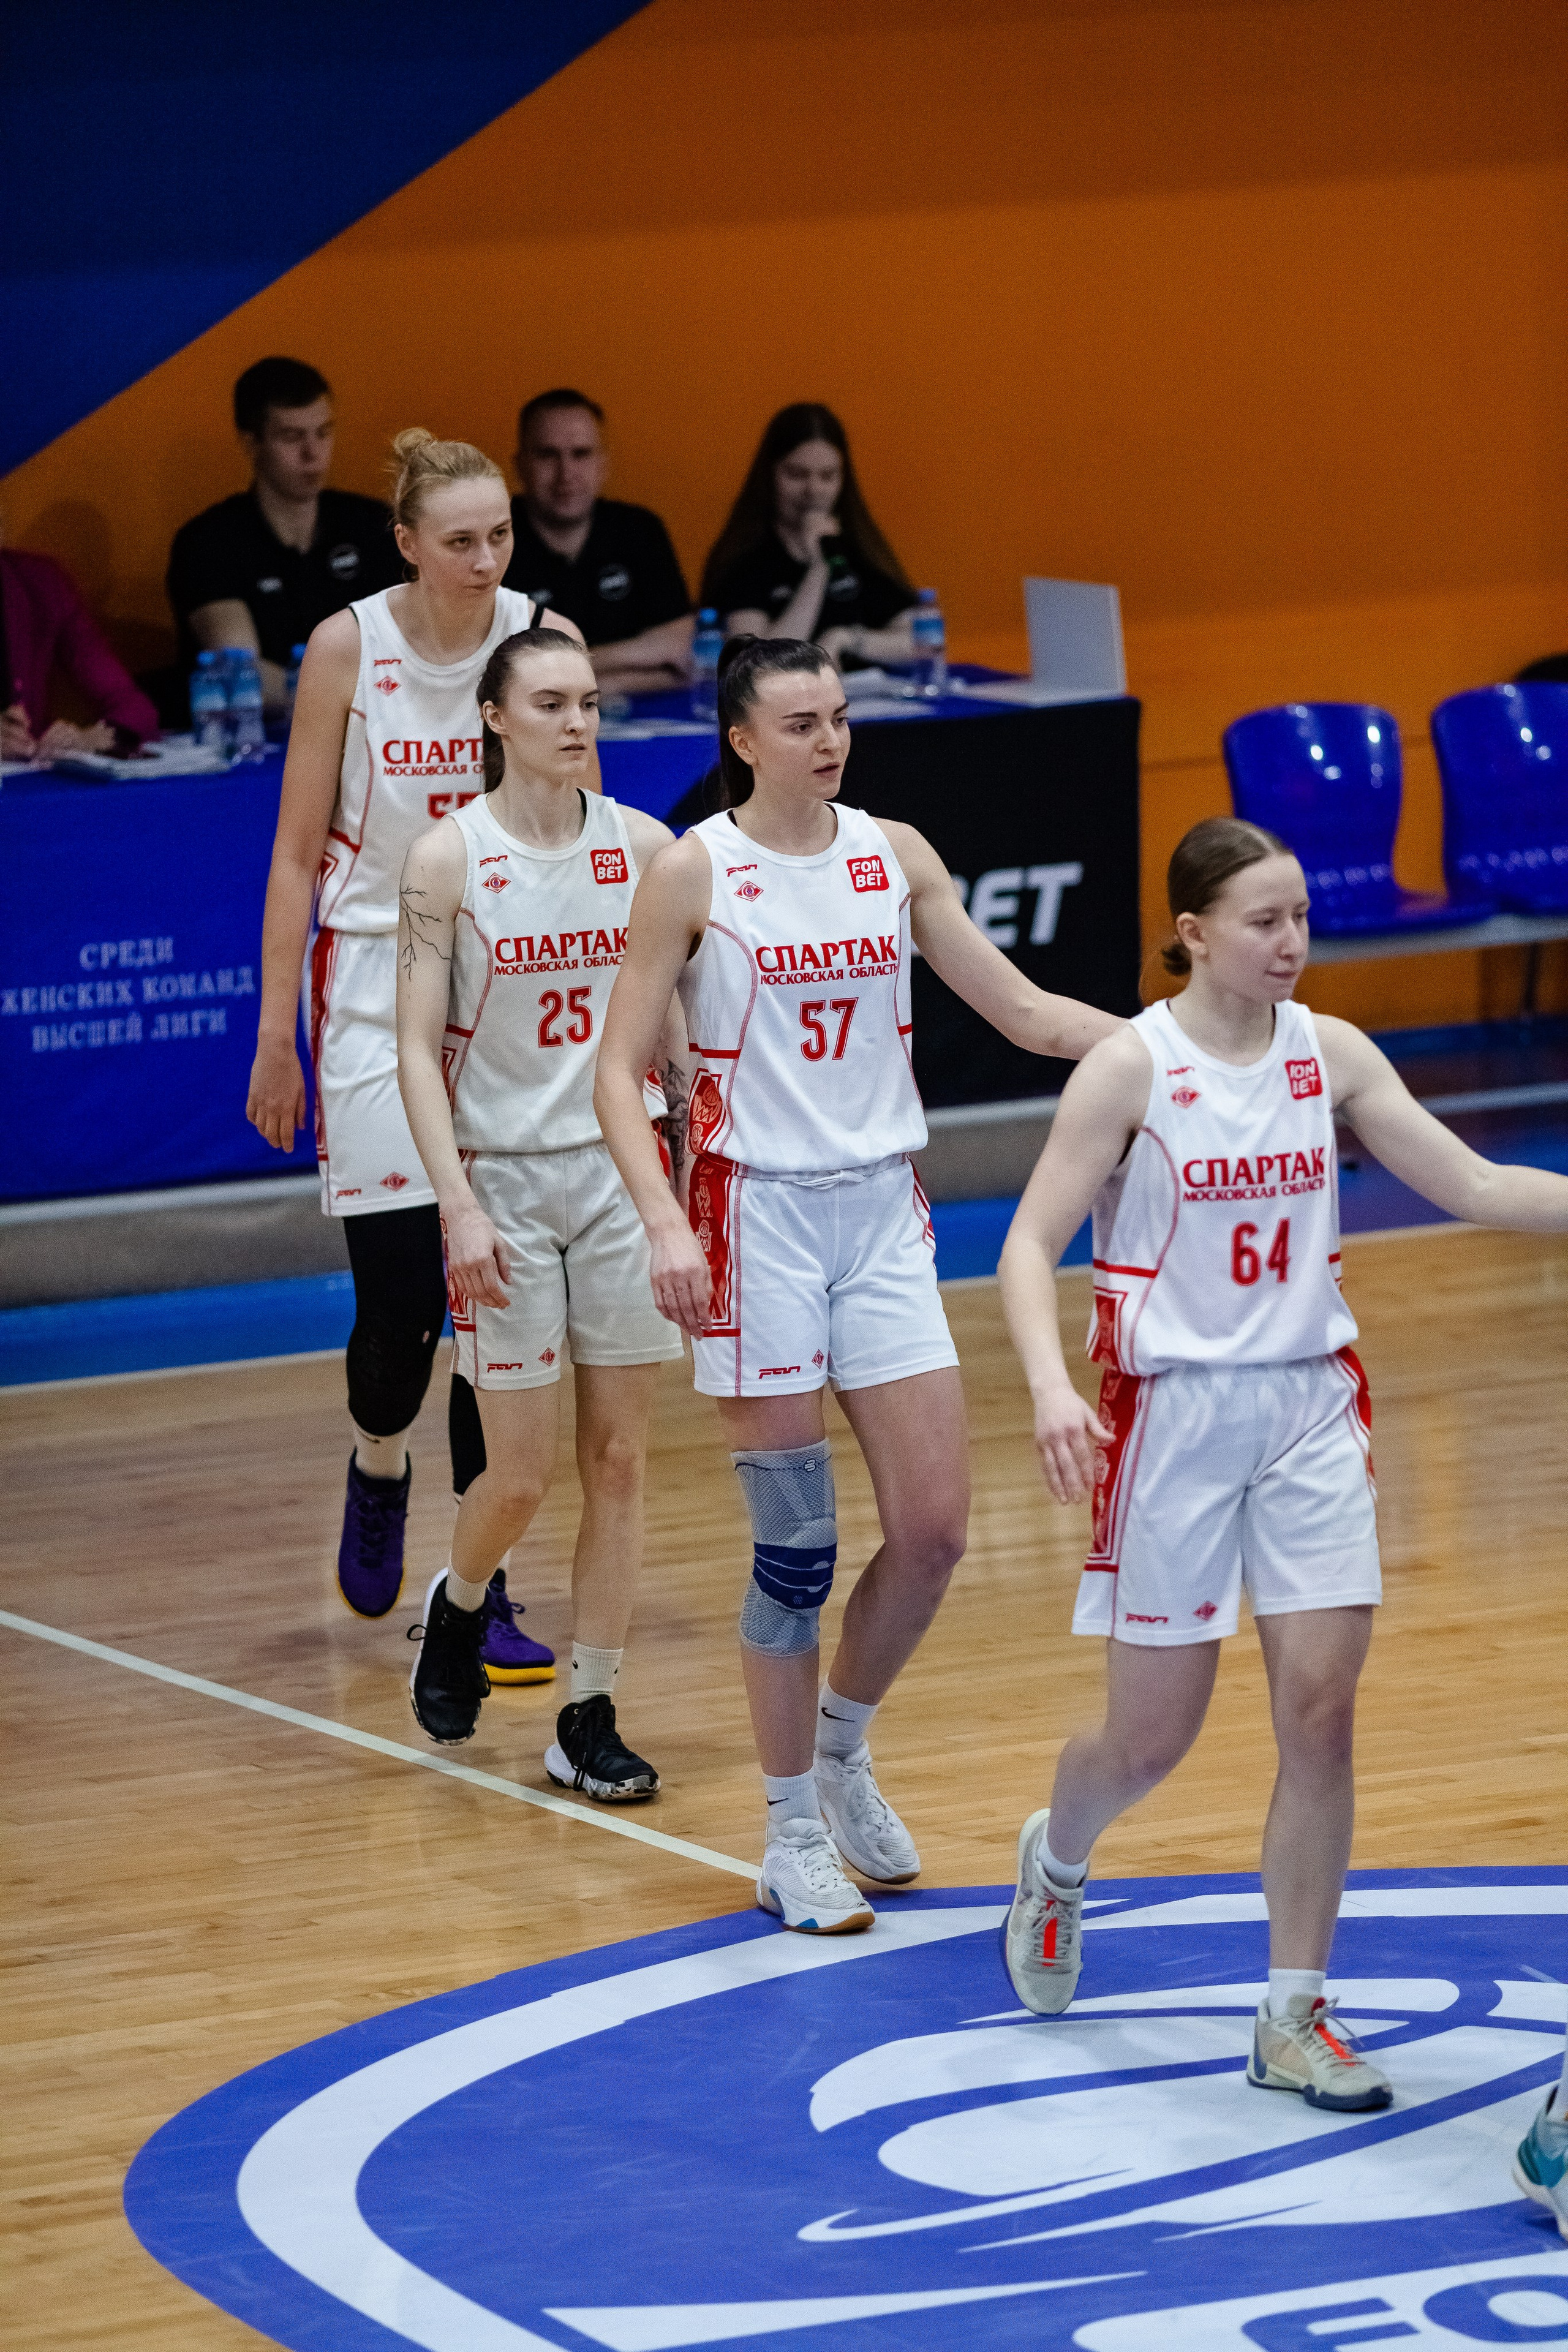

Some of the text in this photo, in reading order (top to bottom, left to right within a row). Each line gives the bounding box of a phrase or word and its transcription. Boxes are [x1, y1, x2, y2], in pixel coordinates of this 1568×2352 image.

[382, 738, 483, 765] СПАРТ
[383, 764, 468, 777] МОСКОВСКАЯ
[595, 851, 622, 866] FON
[597, 864, 624, 880] BET
[851, 859, 880, 875] FON
[856, 872, 883, 888] BET
[79, 937, 174, 971] СРЕДИ
[495, 927, 628, 964] СПАРТАК
[755, 935, 898, 973] СПАРТАК
[494, 954, 624, 976] МОСКОВСКАЯ ОБЛАС
[849, 963, 898, 979] ОБЛАСТЬ
[1, 966, 255, 1017] ЖЕНСКИХ КОМАНД
[31, 1008, 227, 1053] ВЫСШЕЙ ЛИГИ
[538, 986, 593, 1047] 25
[799, 998, 859, 1061] 57
[1183, 1147, 1325, 1188] СПАРТАК
[1231, 1217, 1291, 1287] 64
